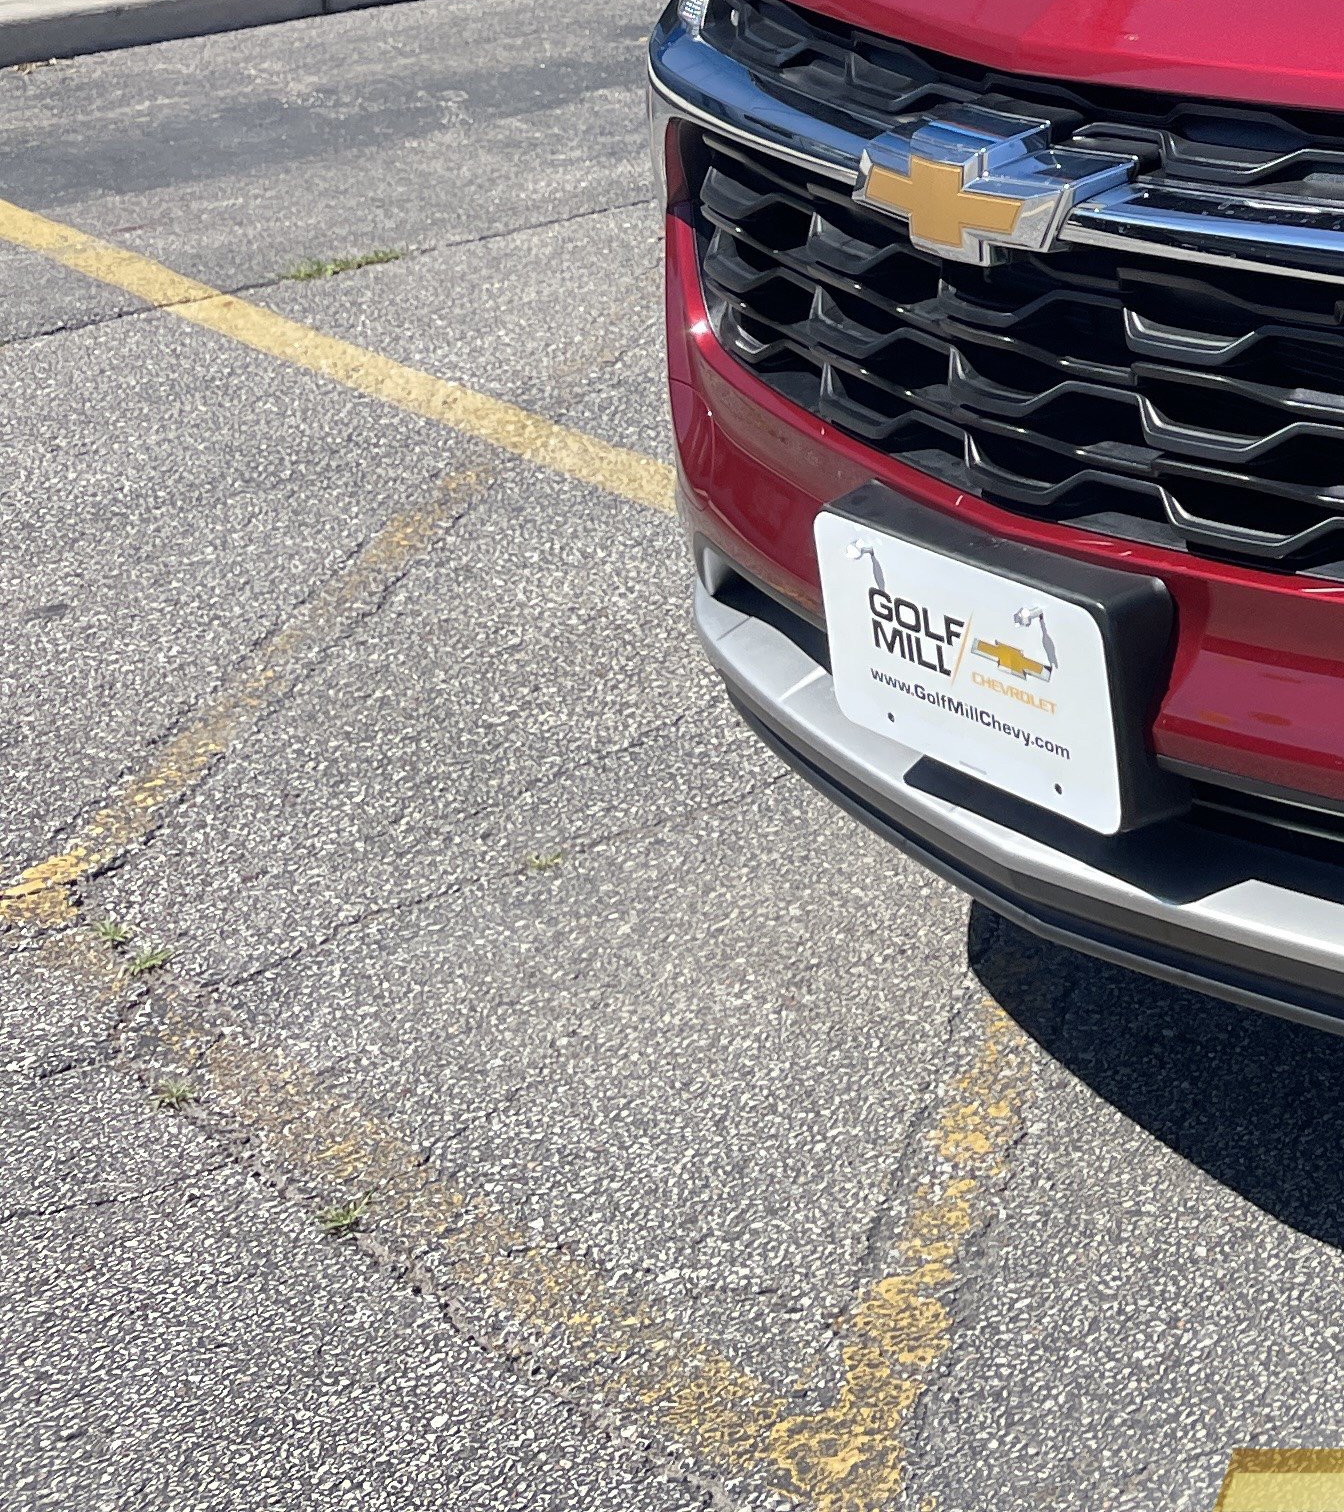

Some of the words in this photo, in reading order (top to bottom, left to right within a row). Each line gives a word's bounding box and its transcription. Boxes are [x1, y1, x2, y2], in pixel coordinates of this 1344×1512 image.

[868, 586, 965, 647] GOLF
[871, 617, 952, 677] MILL
[870, 667, 1071, 760] www.GolfMillChevy.com
[971, 671, 1058, 716] CHEVROLET
